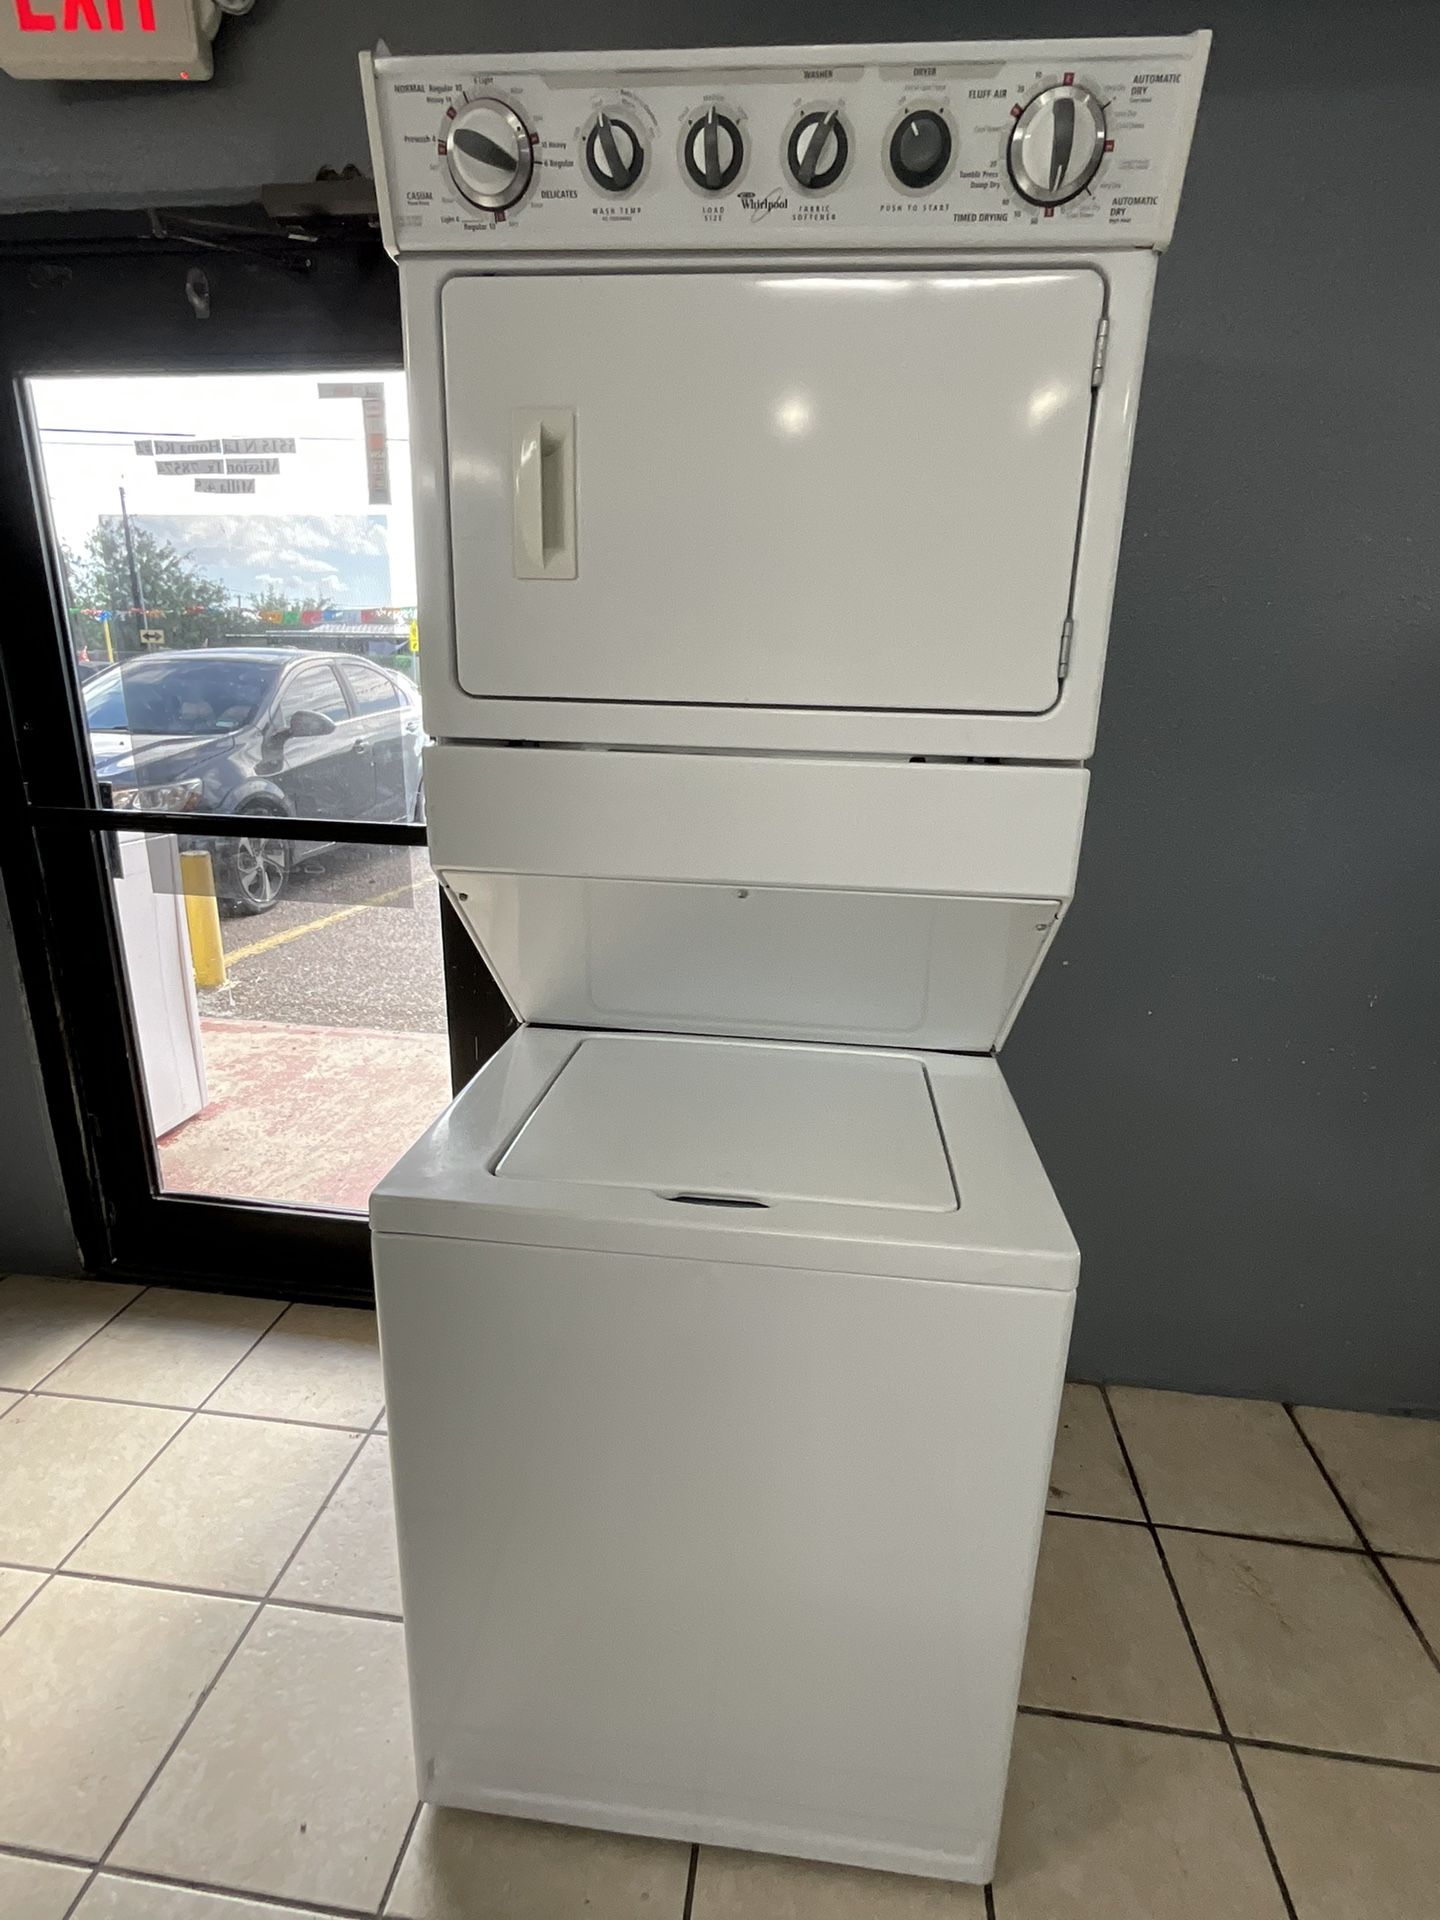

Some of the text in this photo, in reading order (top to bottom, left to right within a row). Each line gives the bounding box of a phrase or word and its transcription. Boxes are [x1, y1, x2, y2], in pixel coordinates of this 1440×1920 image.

[803, 70, 833, 79] WASHER
[913, 67, 937, 77] DRYER
[1133, 74, 1181, 84] AUTOMATIC
[394, 84, 426, 93] NORMAL
[1130, 86, 1148, 96] DRY
[968, 89, 1007, 99] FLUFF AIR
[406, 191, 433, 200] CASUAL
[541, 190, 577, 199] DELICATES
[740, 198, 788, 212] Whirlpool
[1111, 196, 1159, 206] AUTOMATIC
[592, 207, 616, 215] WASH
[702, 206, 725, 215] LOAD
[798, 205, 830, 214] FABRIC
[879, 204, 903, 212] PUSH
[922, 203, 950, 212] START
[792, 213, 837, 221] SOFTENER
[1110, 208, 1126, 217] DRY
[953, 213, 1008, 223] TIMED DRYING
